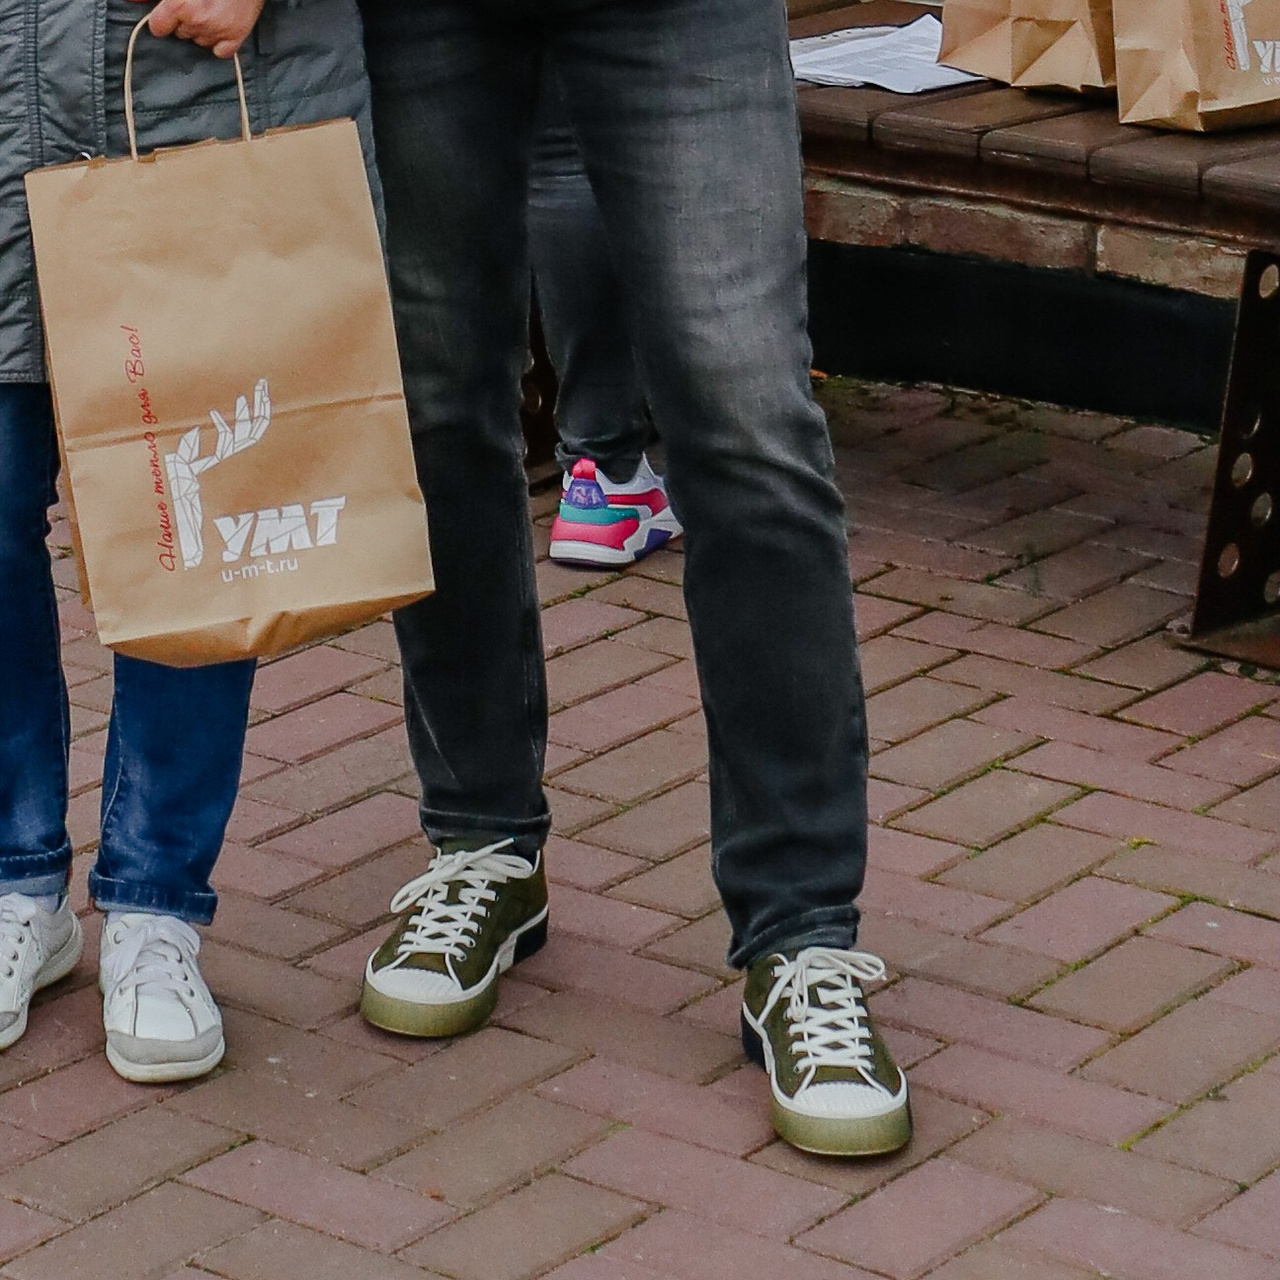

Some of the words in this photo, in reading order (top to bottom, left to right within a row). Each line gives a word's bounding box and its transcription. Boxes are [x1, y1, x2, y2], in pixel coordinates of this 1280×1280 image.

[120, 325, 145, 384] Вас!
[138, 388, 158, 425] для
[144, 431, 165, 494] тепло
[156, 501, 176, 572] Наше
[213, 495, 347, 563] УМТ
[221, 558, 300, 583] u-m-t.ru
